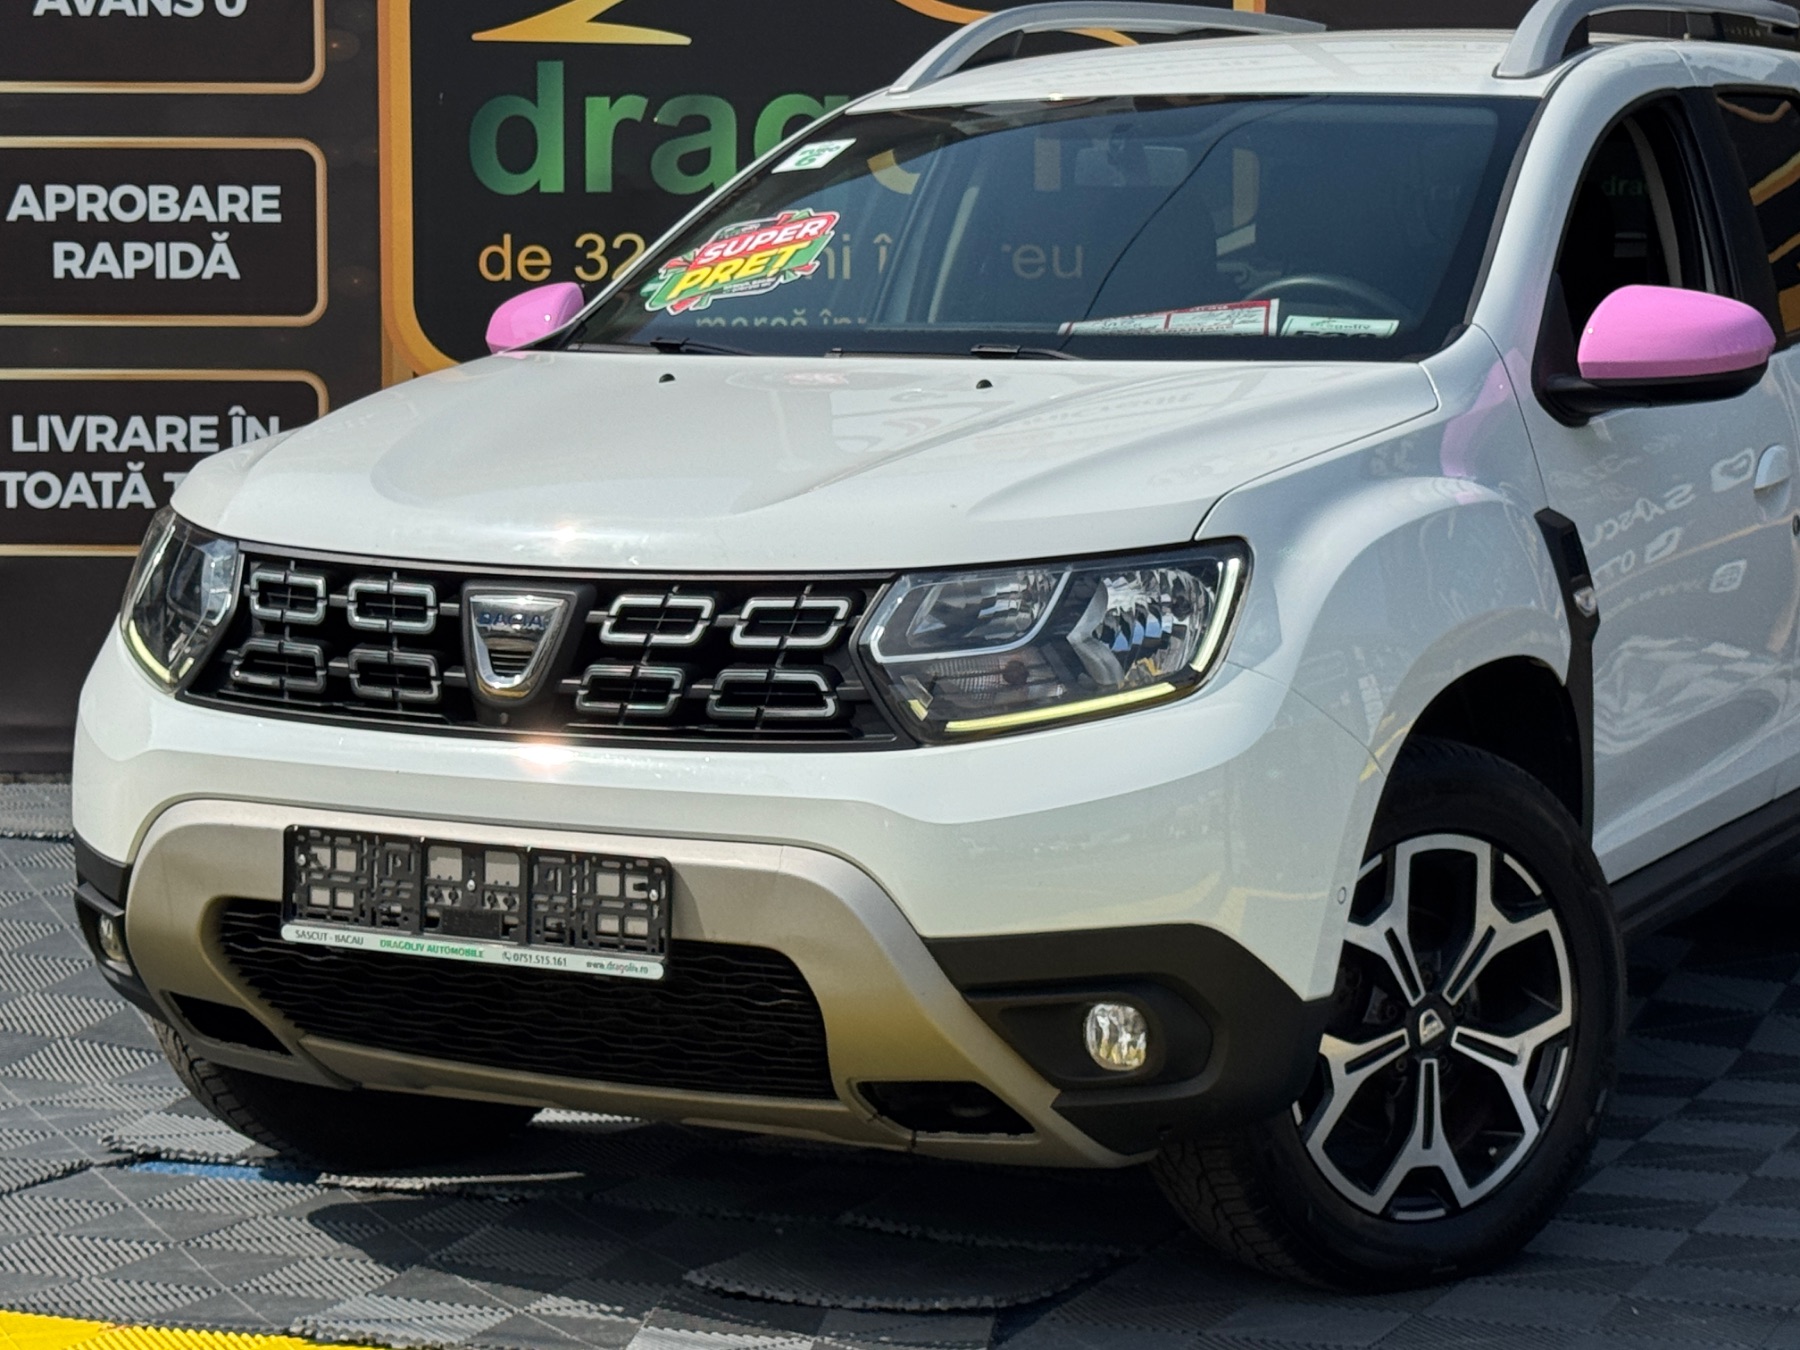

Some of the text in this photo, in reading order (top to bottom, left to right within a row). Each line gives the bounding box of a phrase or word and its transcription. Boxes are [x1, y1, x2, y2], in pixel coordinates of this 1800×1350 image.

[6, 184, 282, 223] APROBARE
[52, 232, 241, 280] RAPIDĂ
[478, 233, 552, 282] de
[574, 232, 646, 282] 32
[696, 216, 829, 266] SUPER
[11, 404, 280, 453] LIVRARE ÎN
[0, 460, 157, 510] TOATĂ
[478, 610, 544, 628] DACIA
[294, 928, 328, 943] SASCUT
[379, 938, 425, 952] DRAGOLIV
[426, 942, 485, 960] AUTOMOBILE
